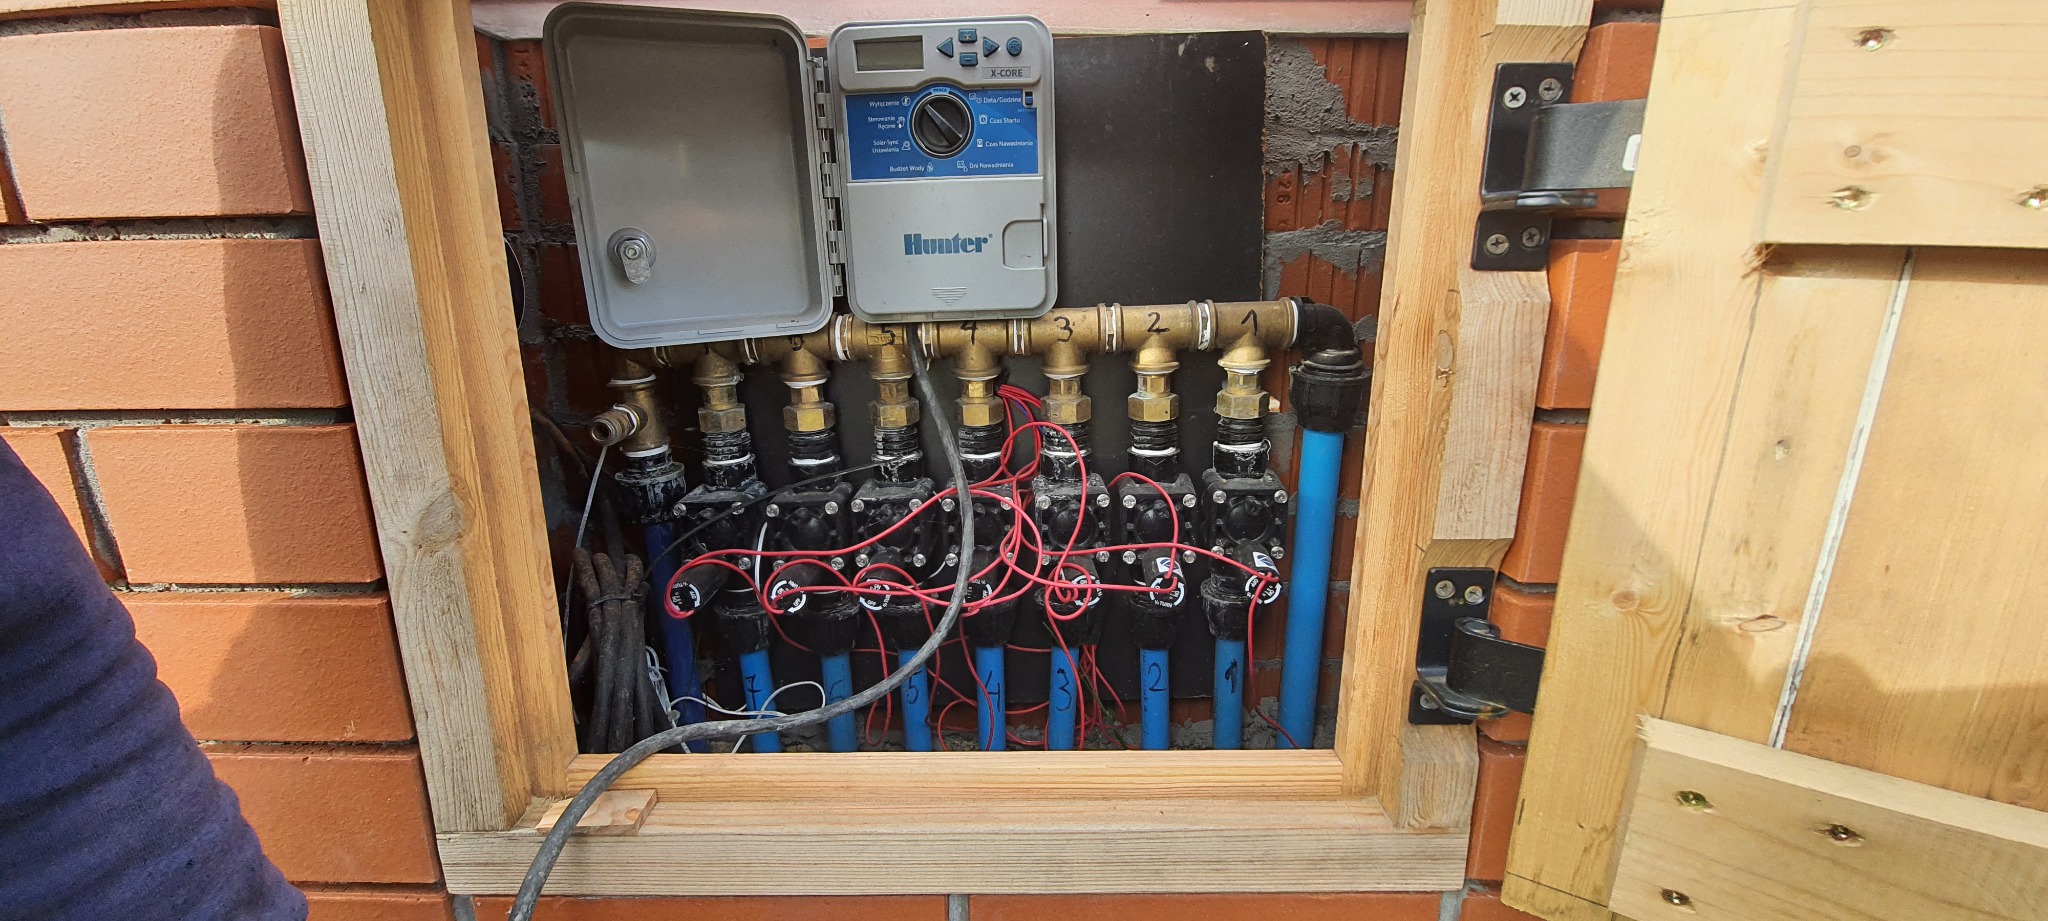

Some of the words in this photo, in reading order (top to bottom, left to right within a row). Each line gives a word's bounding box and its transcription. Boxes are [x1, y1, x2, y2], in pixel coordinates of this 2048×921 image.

[990, 69, 1023, 77] X-CORE
[869, 100, 900, 108] Wyłączenie
[909, 165, 925, 173] Wody
[903, 232, 989, 255] Hunter
[960, 319, 978, 345] 4
[1054, 316, 1074, 342] 3
[1147, 311, 1170, 333] 2
[1240, 309, 1258, 336] 1
[907, 670, 923, 704] 5
[1056, 667, 1073, 711] 3
[1147, 661, 1167, 692] 2
[1224, 658, 1238, 694] 1
[745, 674, 761, 710] 7
[986, 670, 1001, 712] 4
